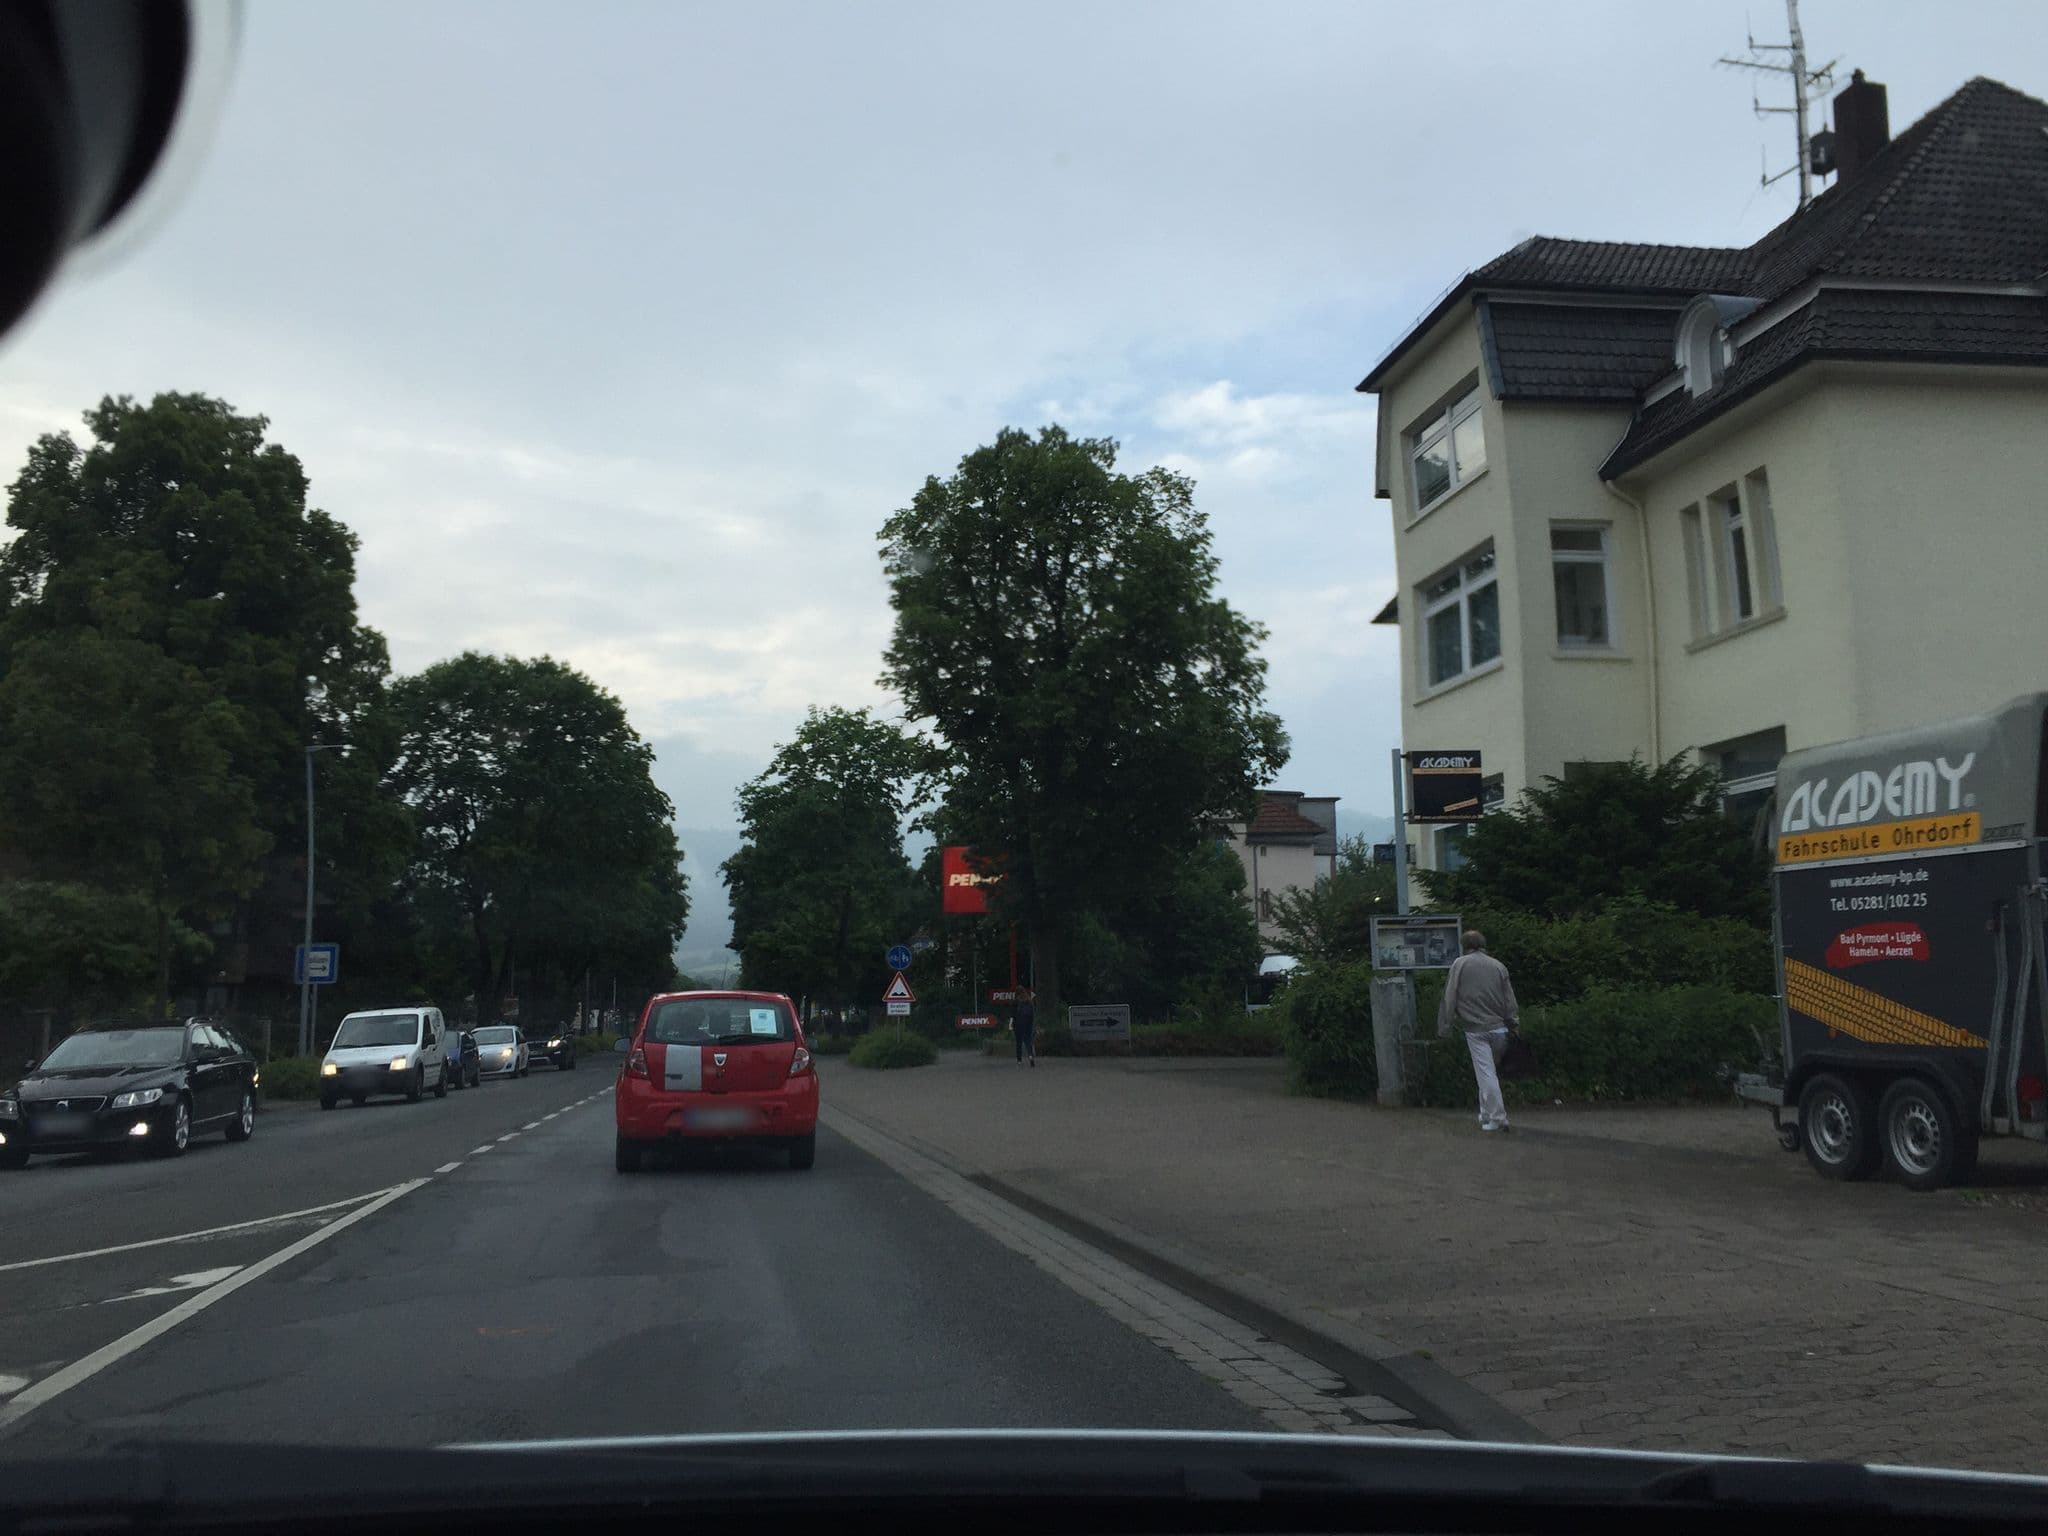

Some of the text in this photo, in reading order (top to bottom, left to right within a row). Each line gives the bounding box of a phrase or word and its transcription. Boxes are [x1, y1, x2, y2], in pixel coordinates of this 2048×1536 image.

[1419, 757, 1474, 768] ACADEMY
[1781, 752, 1976, 832] ACADEMY
[1784, 831, 1881, 858] Fahrschule
[1893, 817, 1972, 847] Ohrdorf
[1830, 868, 1929, 888] www.academy-bp.de
[1851, 894, 1910, 911] 05281/102
[1912, 893, 1928, 907] 25
[1840, 931, 1922, 946] Bad Pyrmont Lügde
[1849, 945, 1913, 957] Hameln Aerzen
